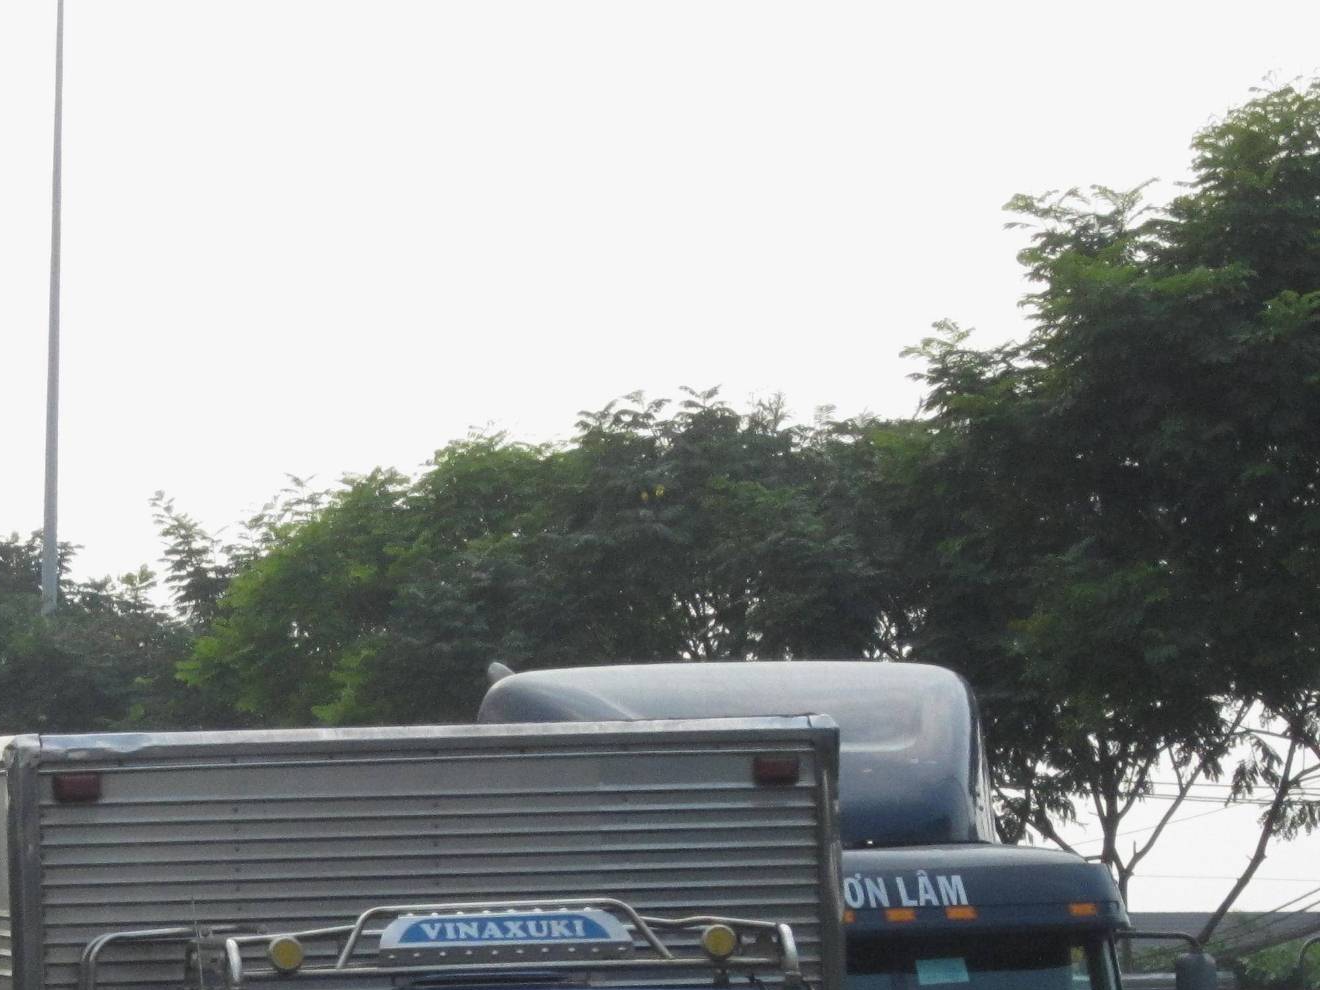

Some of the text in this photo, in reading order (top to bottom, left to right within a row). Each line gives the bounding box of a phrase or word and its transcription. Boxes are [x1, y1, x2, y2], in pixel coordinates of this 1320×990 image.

[843, 869, 969, 908] ƠN LÂM
[418, 919, 587, 940] VINAXUKI
